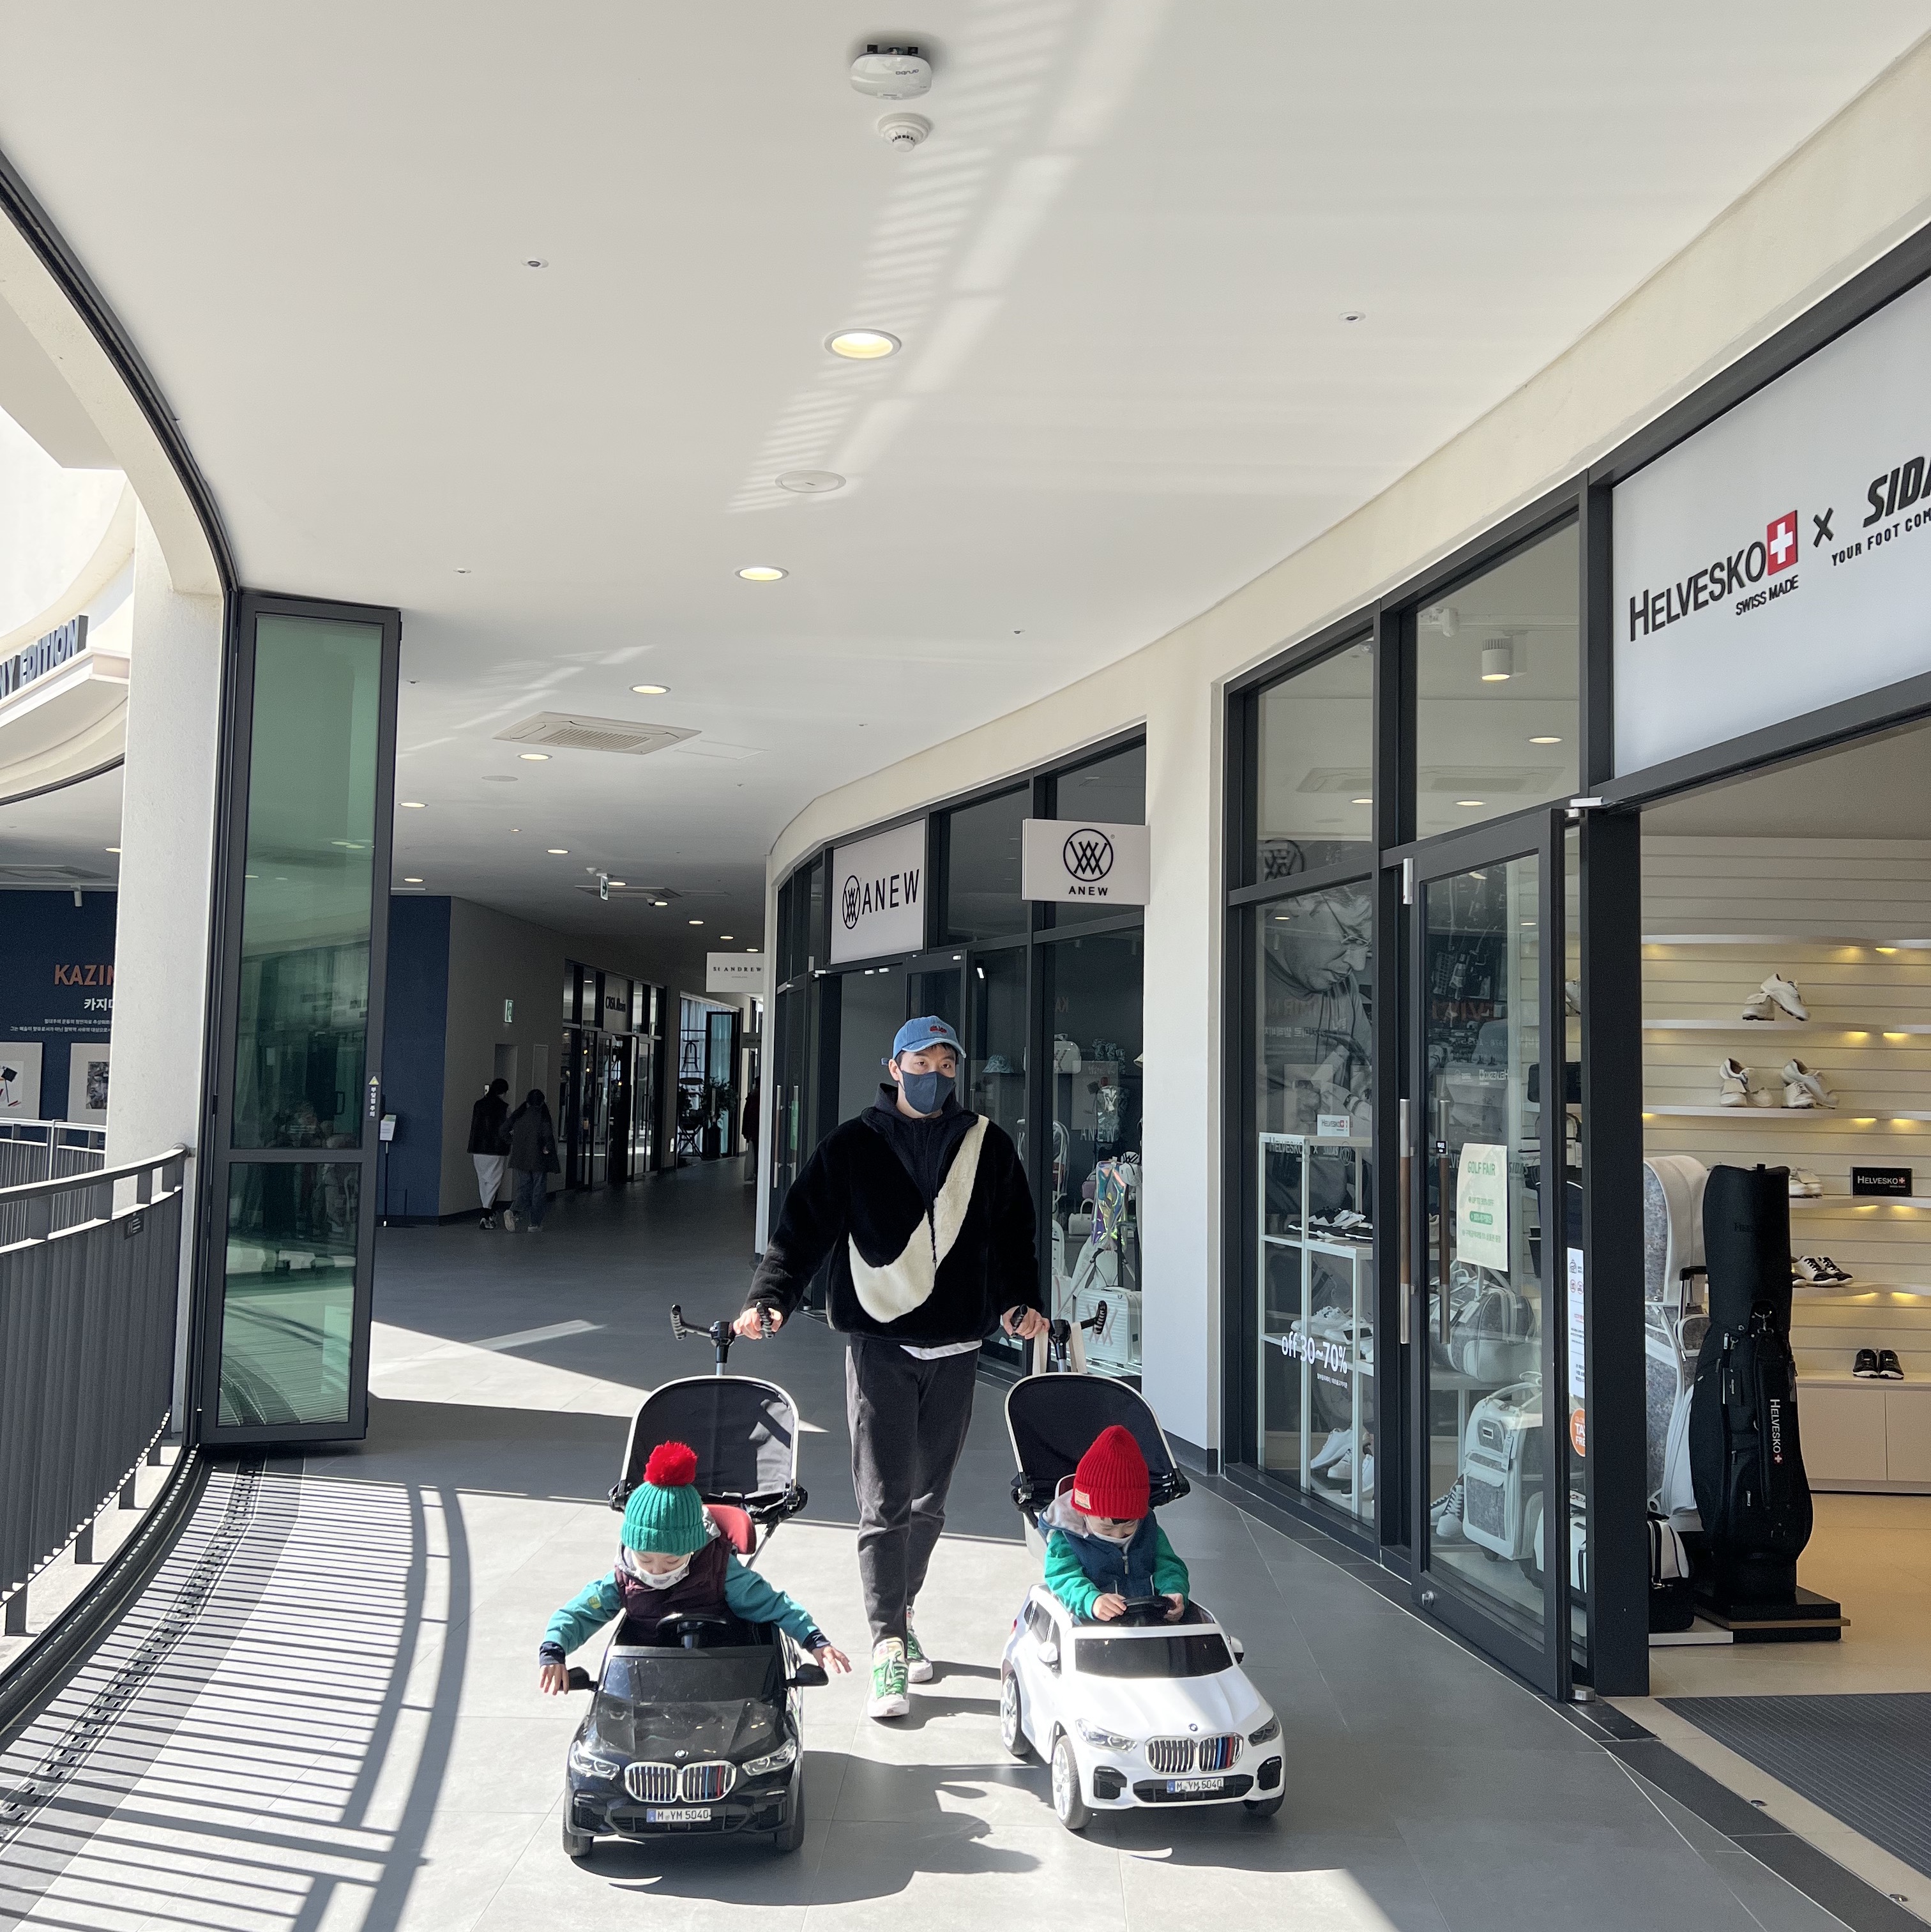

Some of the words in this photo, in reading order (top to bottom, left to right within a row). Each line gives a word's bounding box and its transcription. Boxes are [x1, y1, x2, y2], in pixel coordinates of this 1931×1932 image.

[1831, 543, 1861, 566] YOUR
[1867, 523, 1900, 550] FOOT
[1630, 542, 1766, 642] HELVESKO
[1736, 591, 1766, 616] SWISS
[1769, 574, 1799, 600] MADE
[20, 615, 88, 687] EDITION
[861, 869, 920, 915] ANEW
[1068, 886, 1108, 896] ANEW
[1467, 1160, 1482, 1175] GOLF
[1482, 1162, 1496, 1176] FAIR
[1857, 1175, 1898, 1185] HELVESKO
[1282, 1331, 1298, 1358] off
[1300, 1335, 1347, 1374] 30~70%
[1574, 1422, 1585, 1436] TA
[1770, 1399, 1781, 1454] HELVESKO
[1176, 1781, 1183, 1790] M
[657, 1811, 663, 1820] M
[670, 1811, 683, 1820] YM
[685, 1809, 709, 1820] 5040
